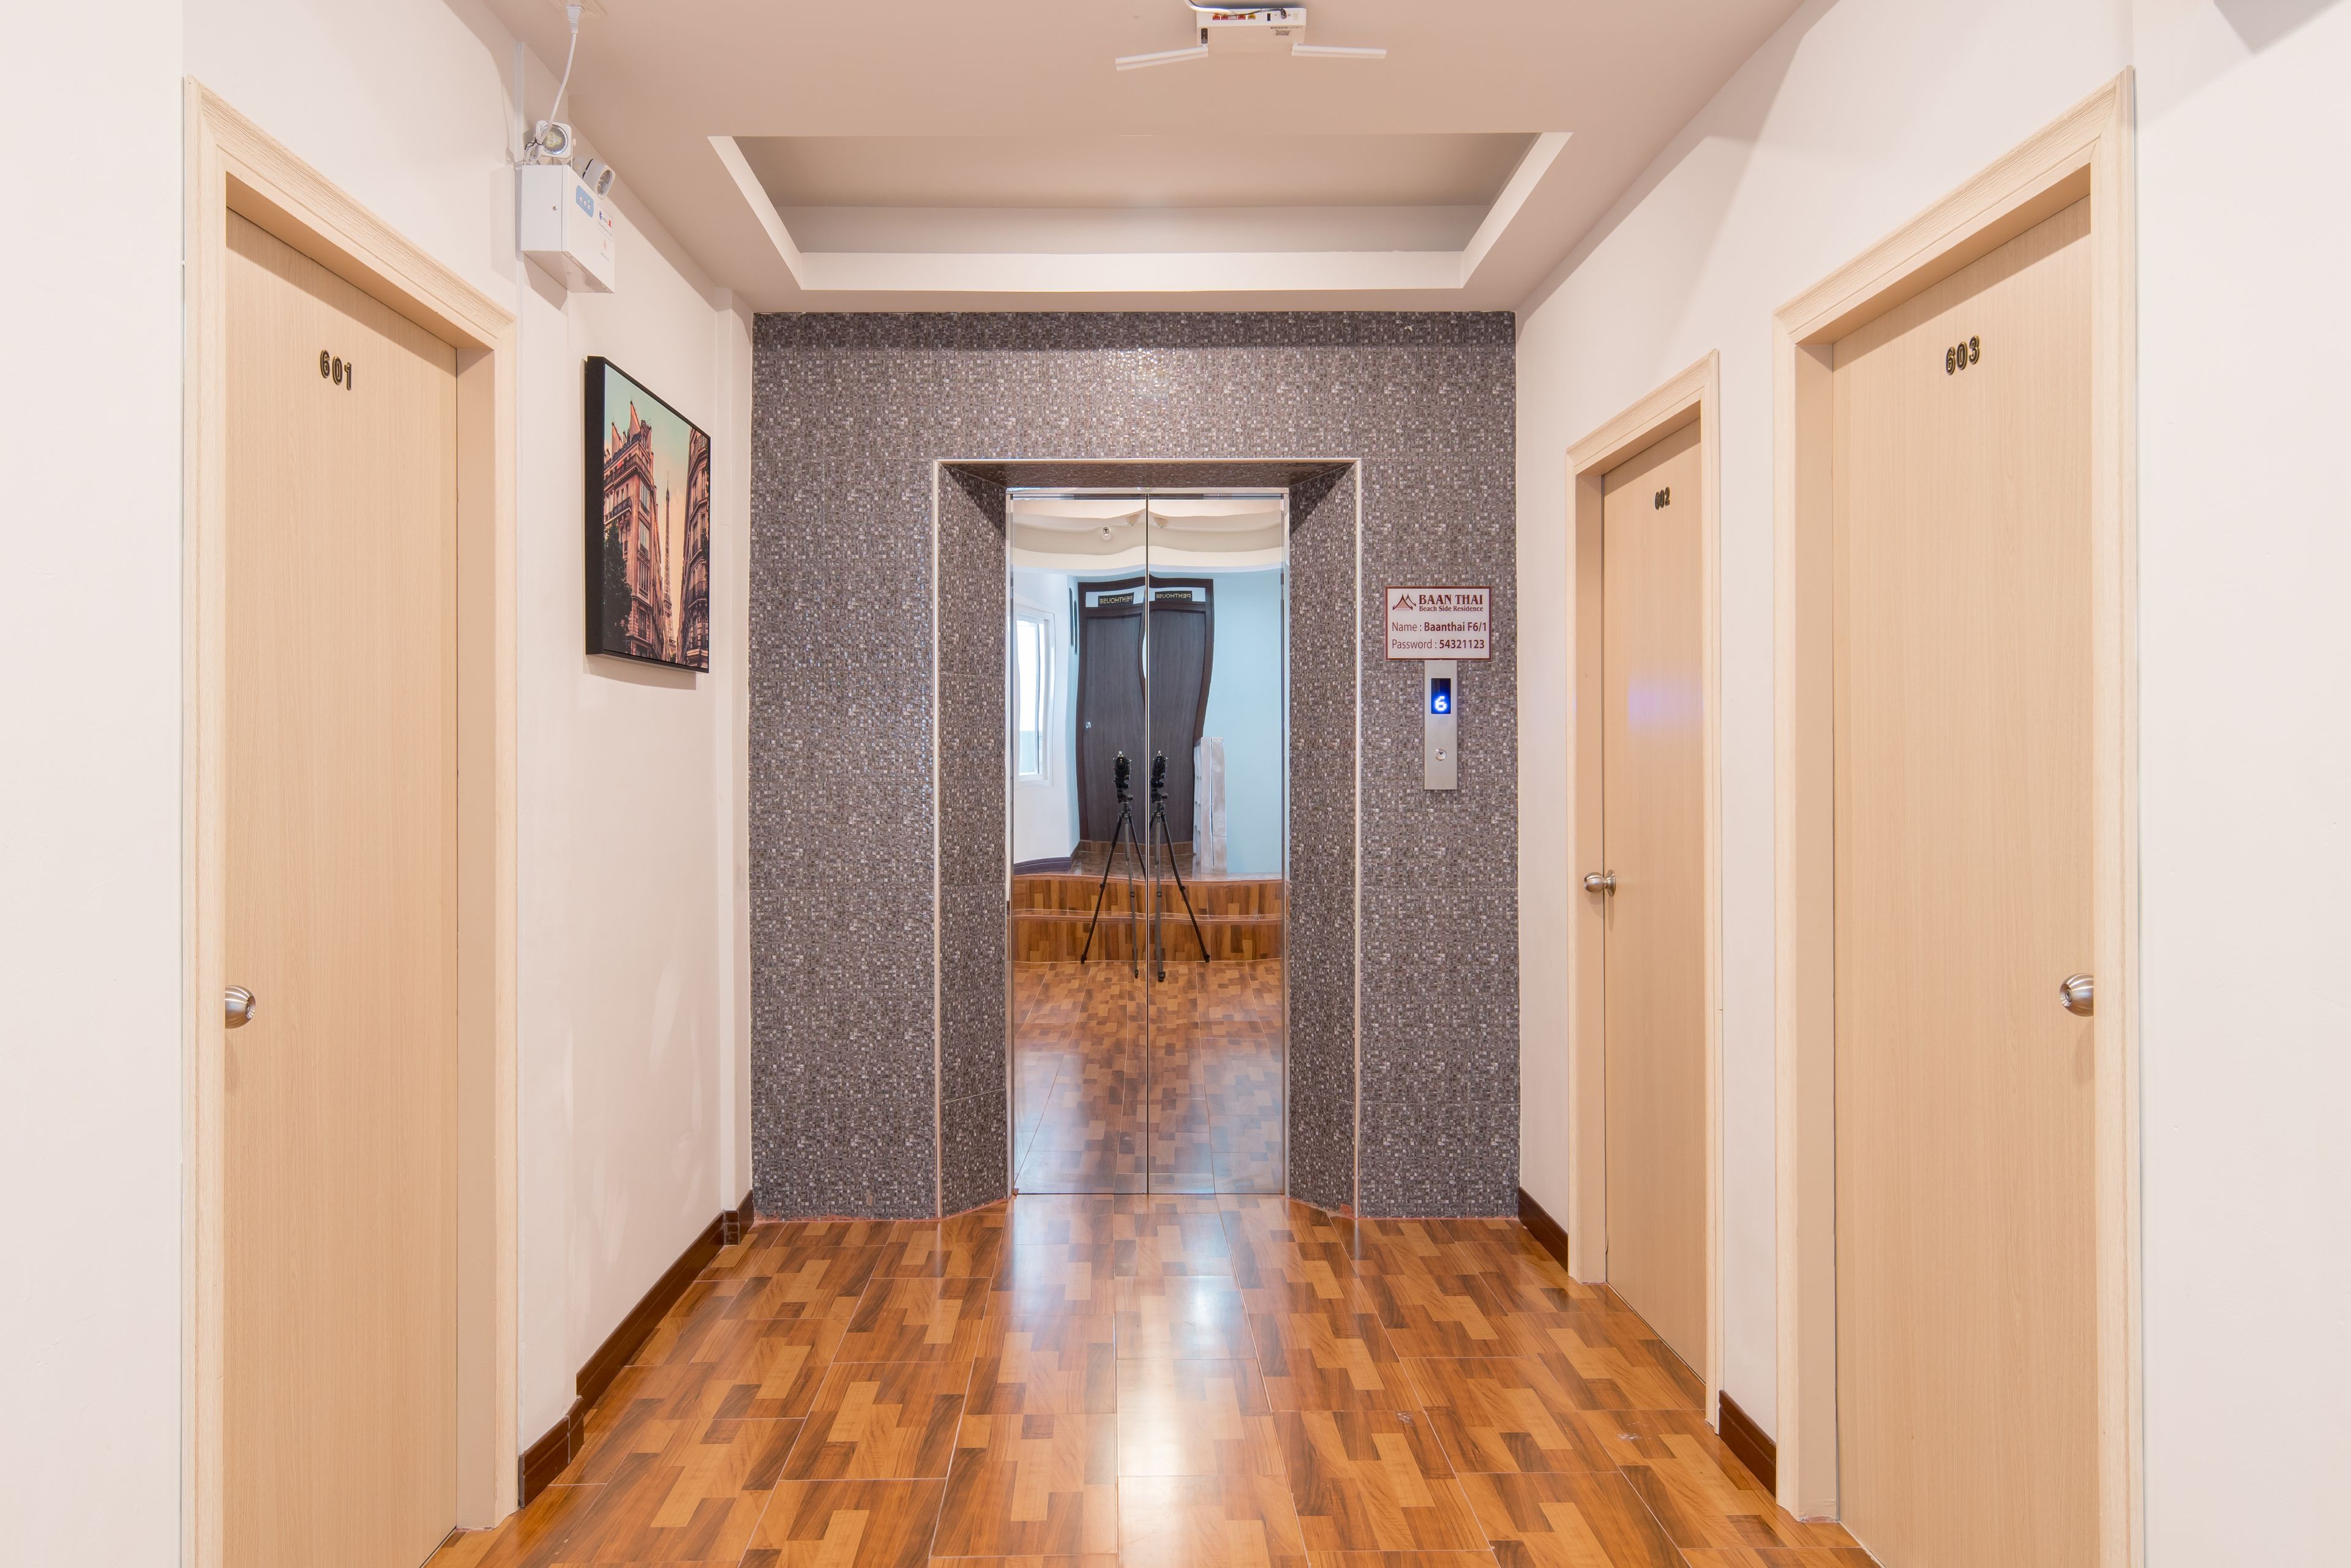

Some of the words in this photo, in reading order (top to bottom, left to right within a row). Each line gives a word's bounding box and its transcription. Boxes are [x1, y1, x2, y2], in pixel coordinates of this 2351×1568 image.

[1946, 335, 1979, 375] 603
[320, 349, 351, 390] 601
[1419, 595, 1452, 604] BAAN
[1455, 595, 1483, 604] THAI
[1424, 621, 1465, 631] Baanthai
[1468, 622, 1487, 632] F6/1
[1439, 639, 1485, 649] 54321123
[1434, 696, 1447, 711] 6
